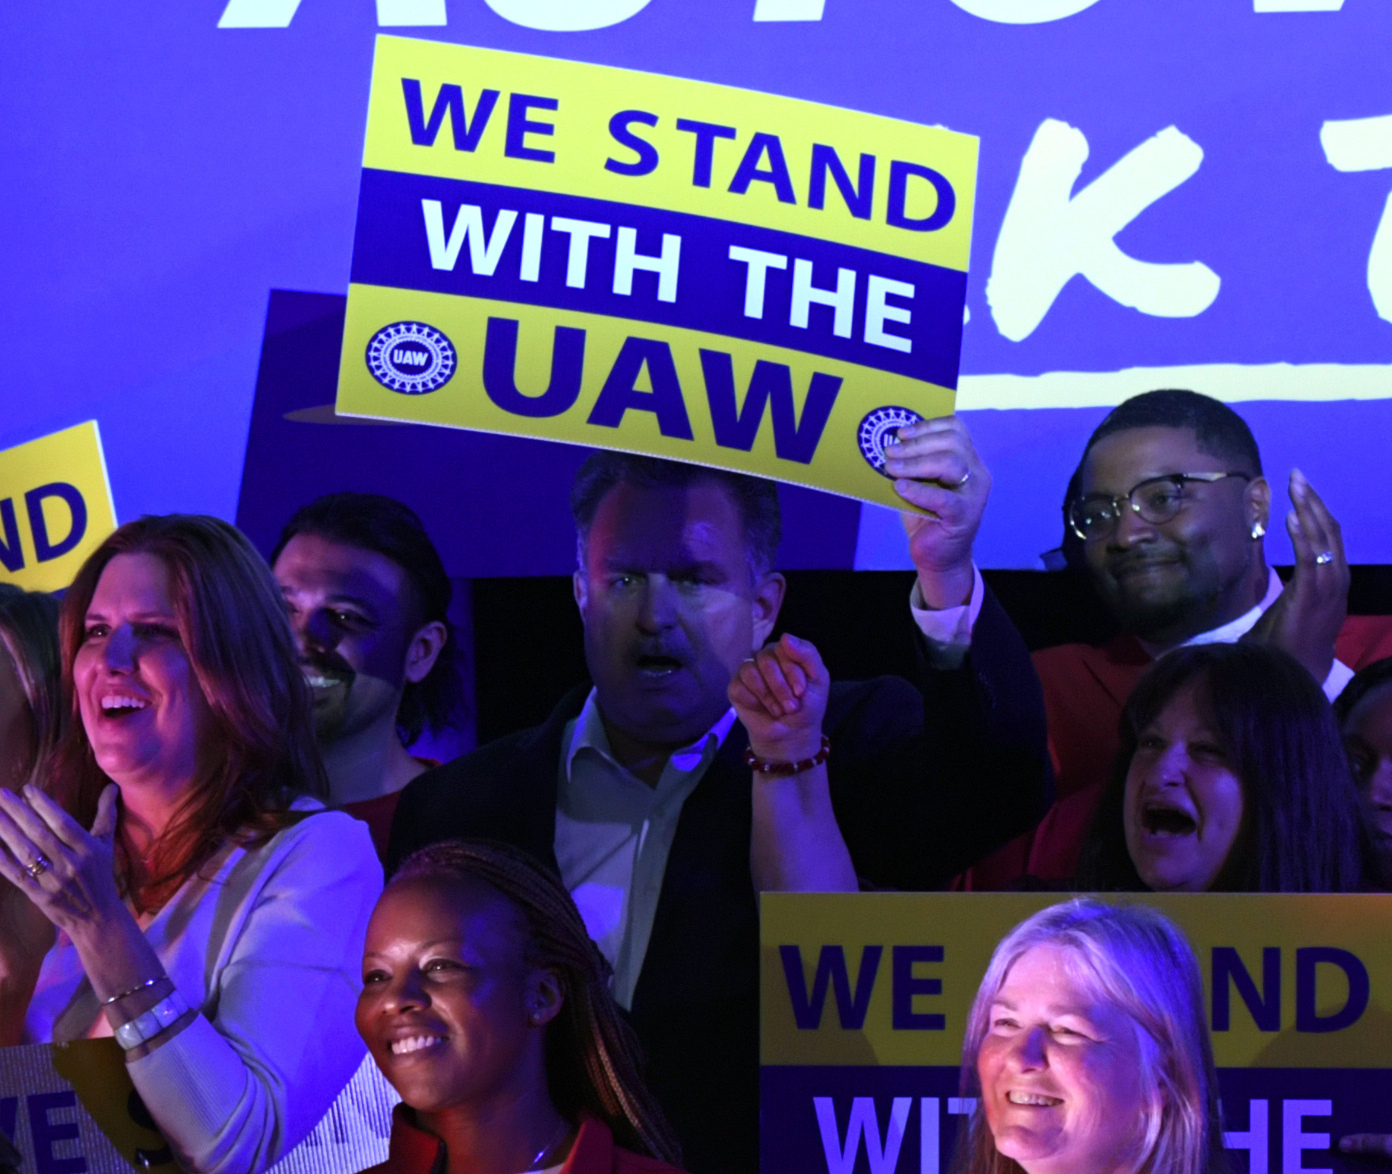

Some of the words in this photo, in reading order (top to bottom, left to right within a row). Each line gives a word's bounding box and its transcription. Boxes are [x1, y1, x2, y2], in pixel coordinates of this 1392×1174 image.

[401, 77, 559, 164] WE
[603, 109, 956, 233] STAND
[421, 198, 682, 304] WITH
[728, 244, 915, 354] THE
[393, 349, 429, 367] UAW
[481, 316, 844, 465] UAW
[779, 944, 946, 1031] WE
